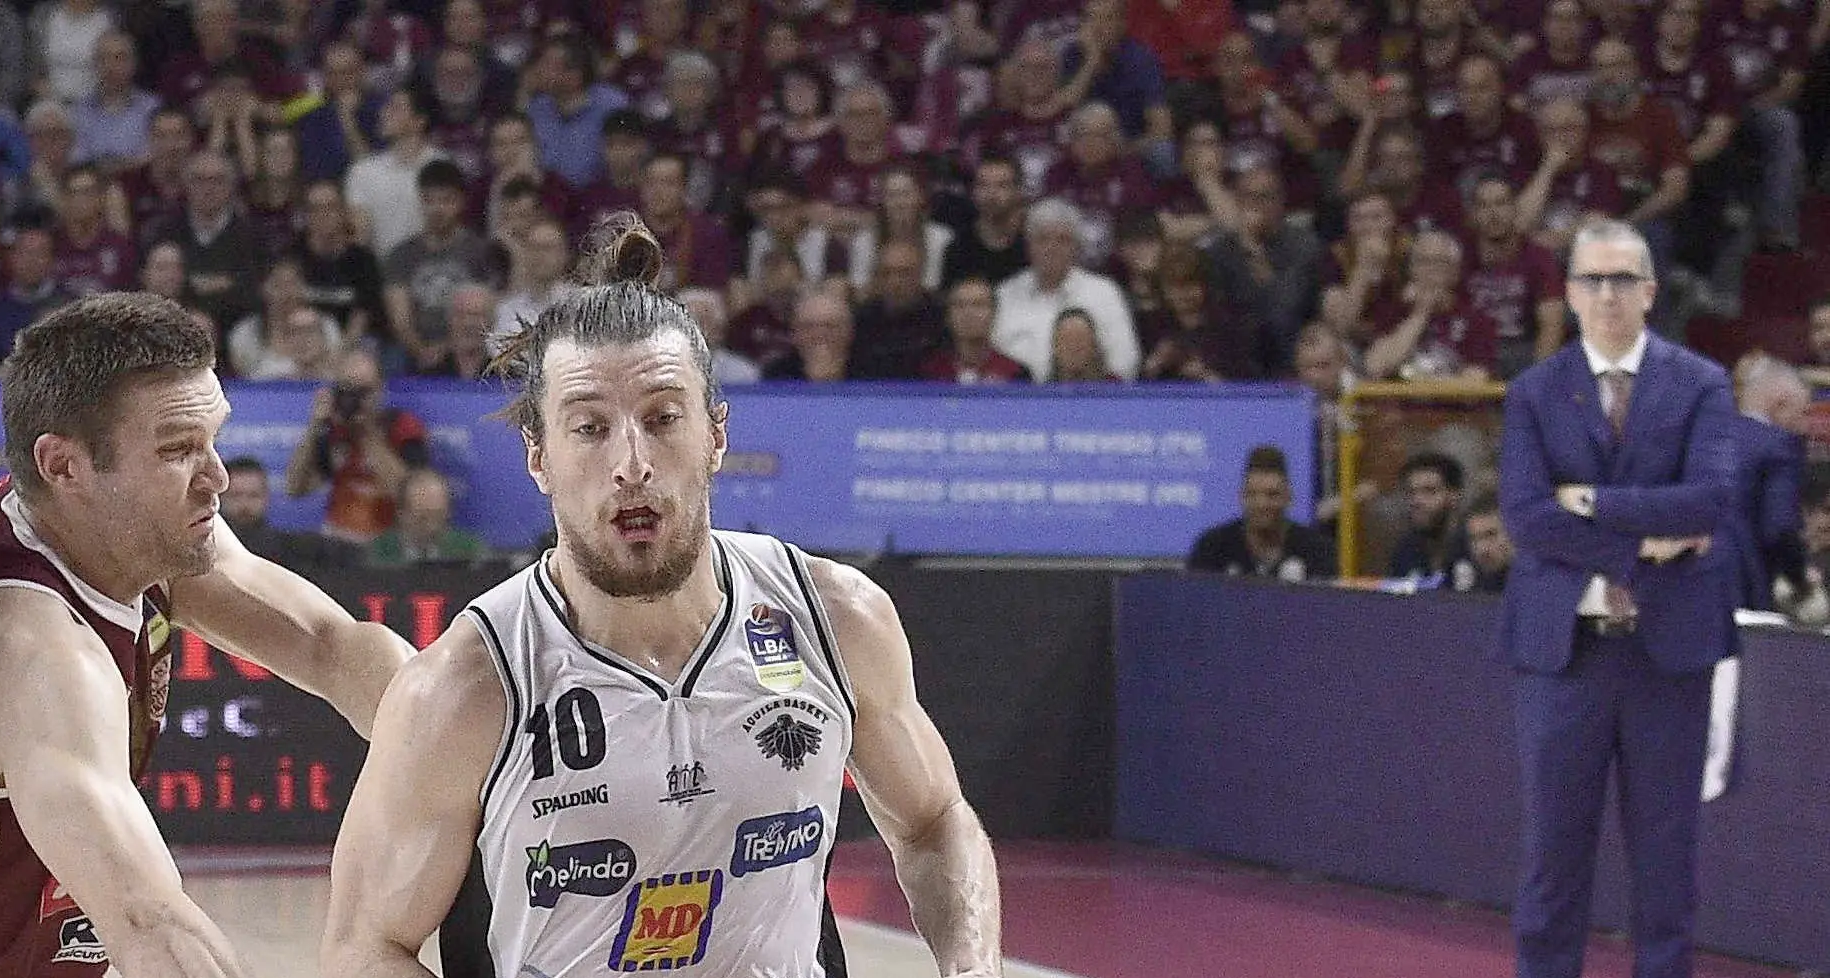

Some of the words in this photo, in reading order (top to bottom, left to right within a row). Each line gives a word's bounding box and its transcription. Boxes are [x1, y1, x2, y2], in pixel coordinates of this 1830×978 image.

[753, 637, 793, 656] LBA
[525, 687, 606, 781] 10
[533, 784, 609, 819] SPALDING
[530, 853, 630, 898] Melinda
[633, 903, 703, 940] MD
